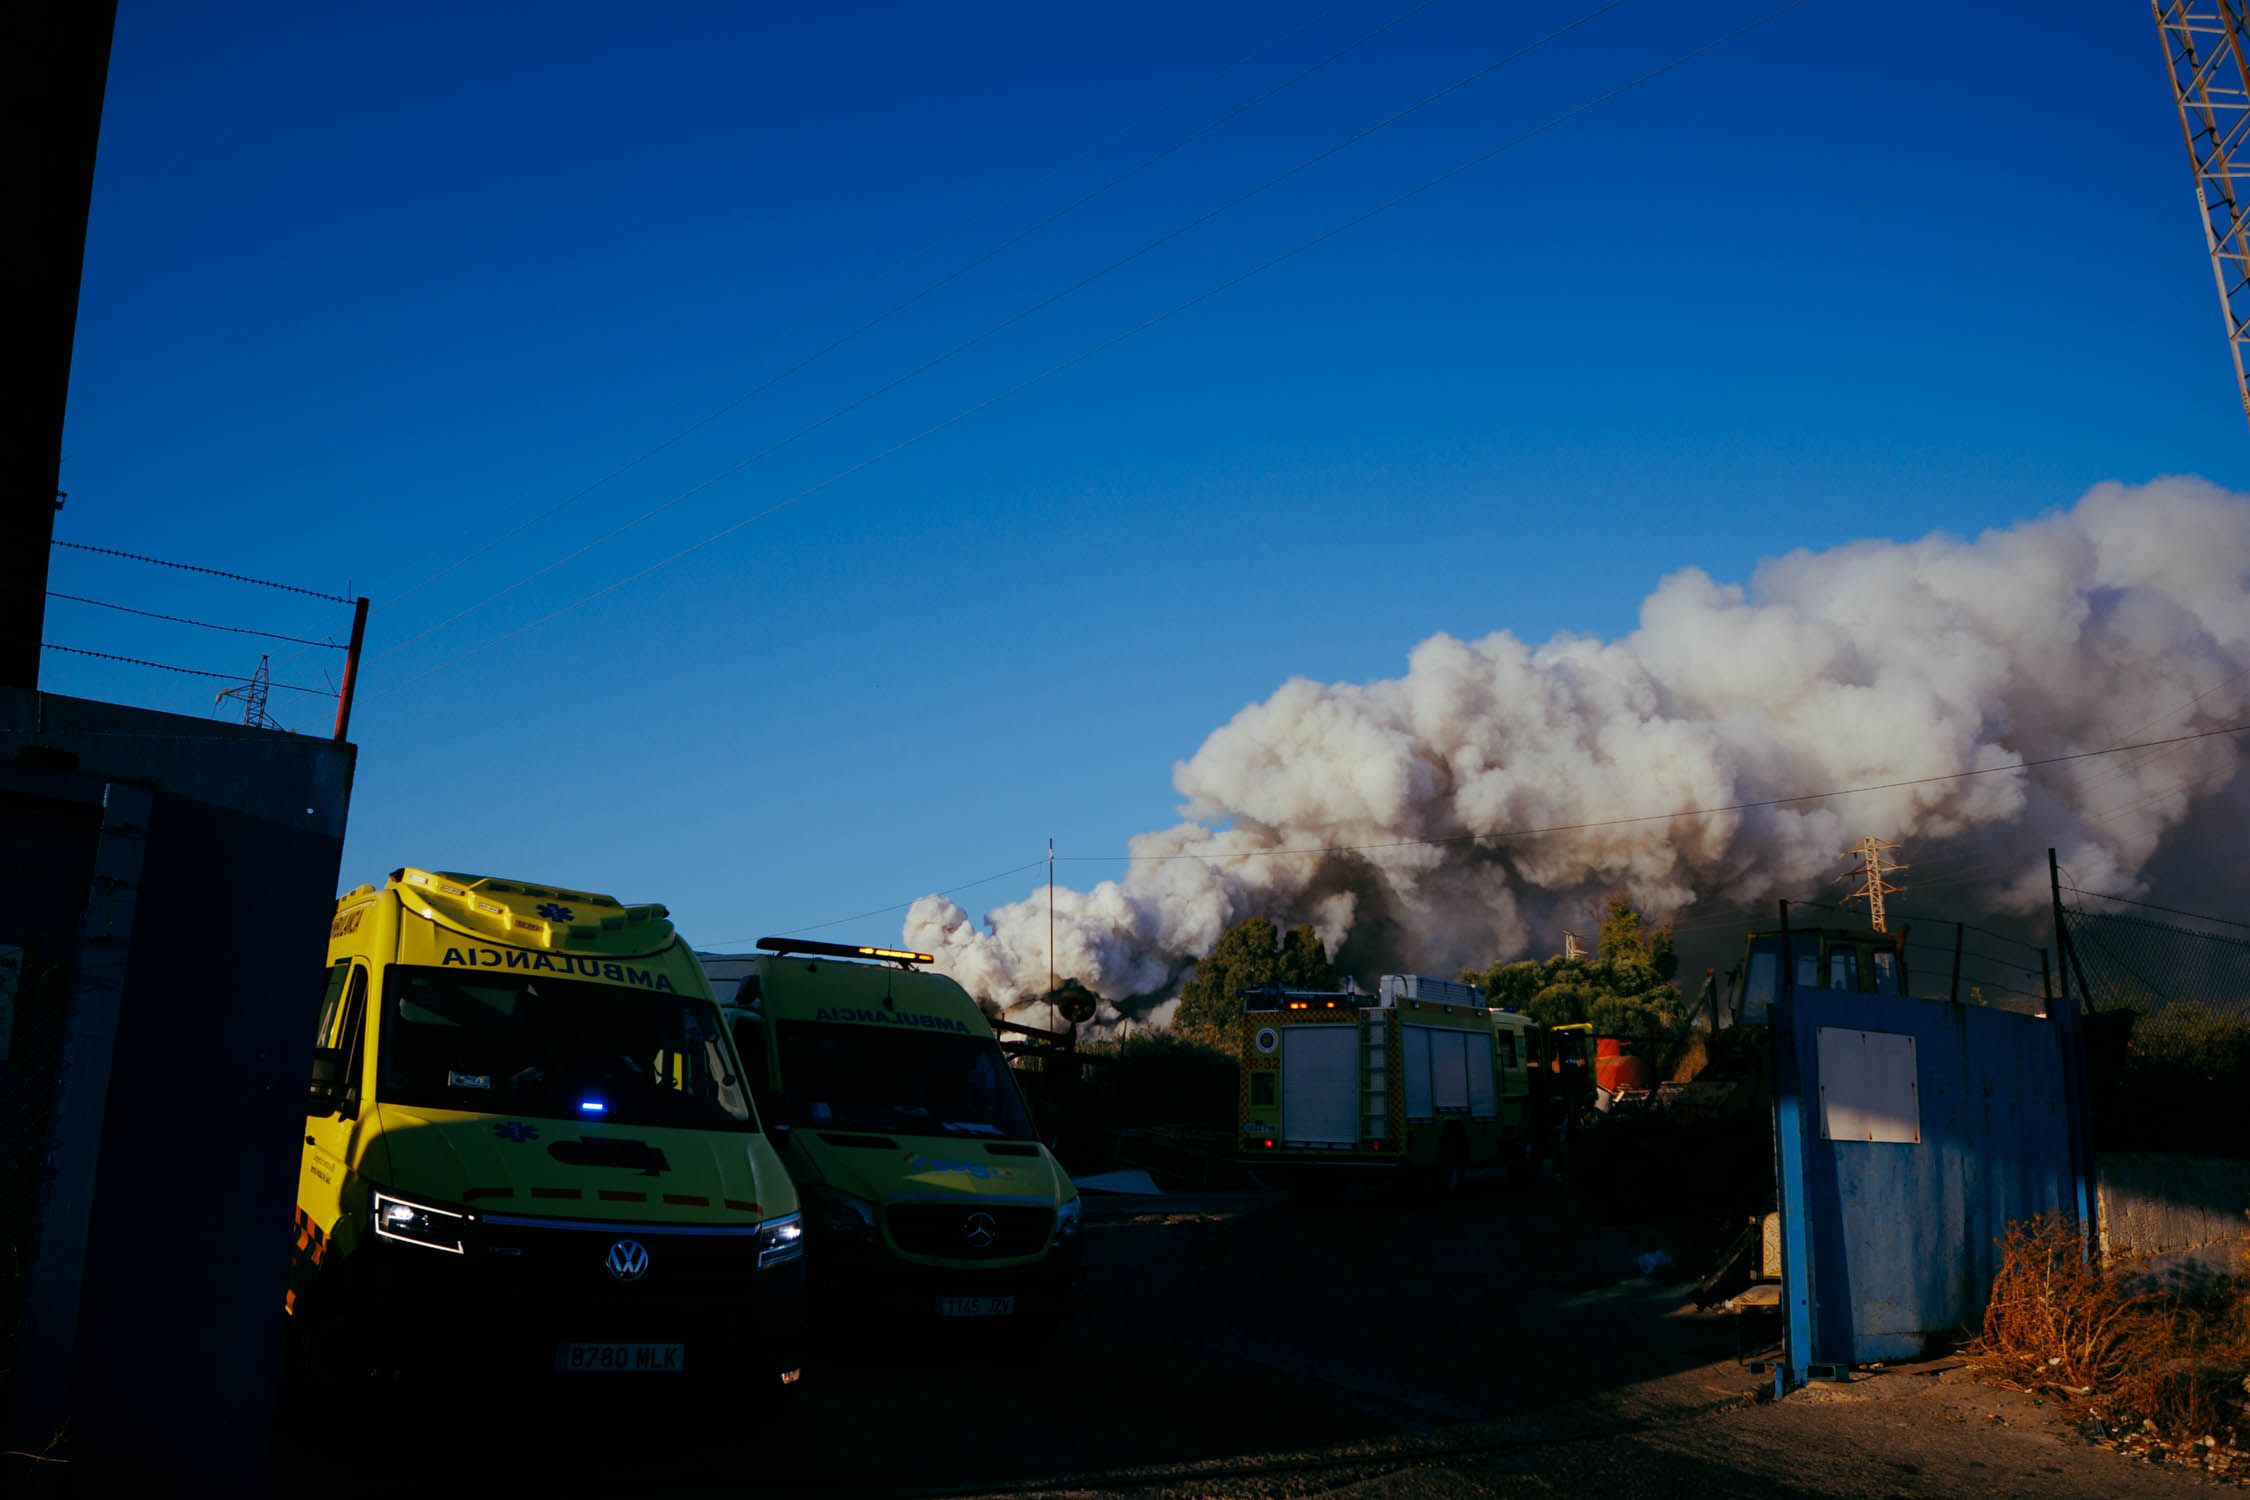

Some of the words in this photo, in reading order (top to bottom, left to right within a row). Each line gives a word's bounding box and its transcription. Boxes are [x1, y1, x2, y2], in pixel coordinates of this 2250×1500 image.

[1248, 1057, 1281, 1070] R-32
[571, 1346, 628, 1369] 8780
[636, 1346, 678, 1369] MLK
